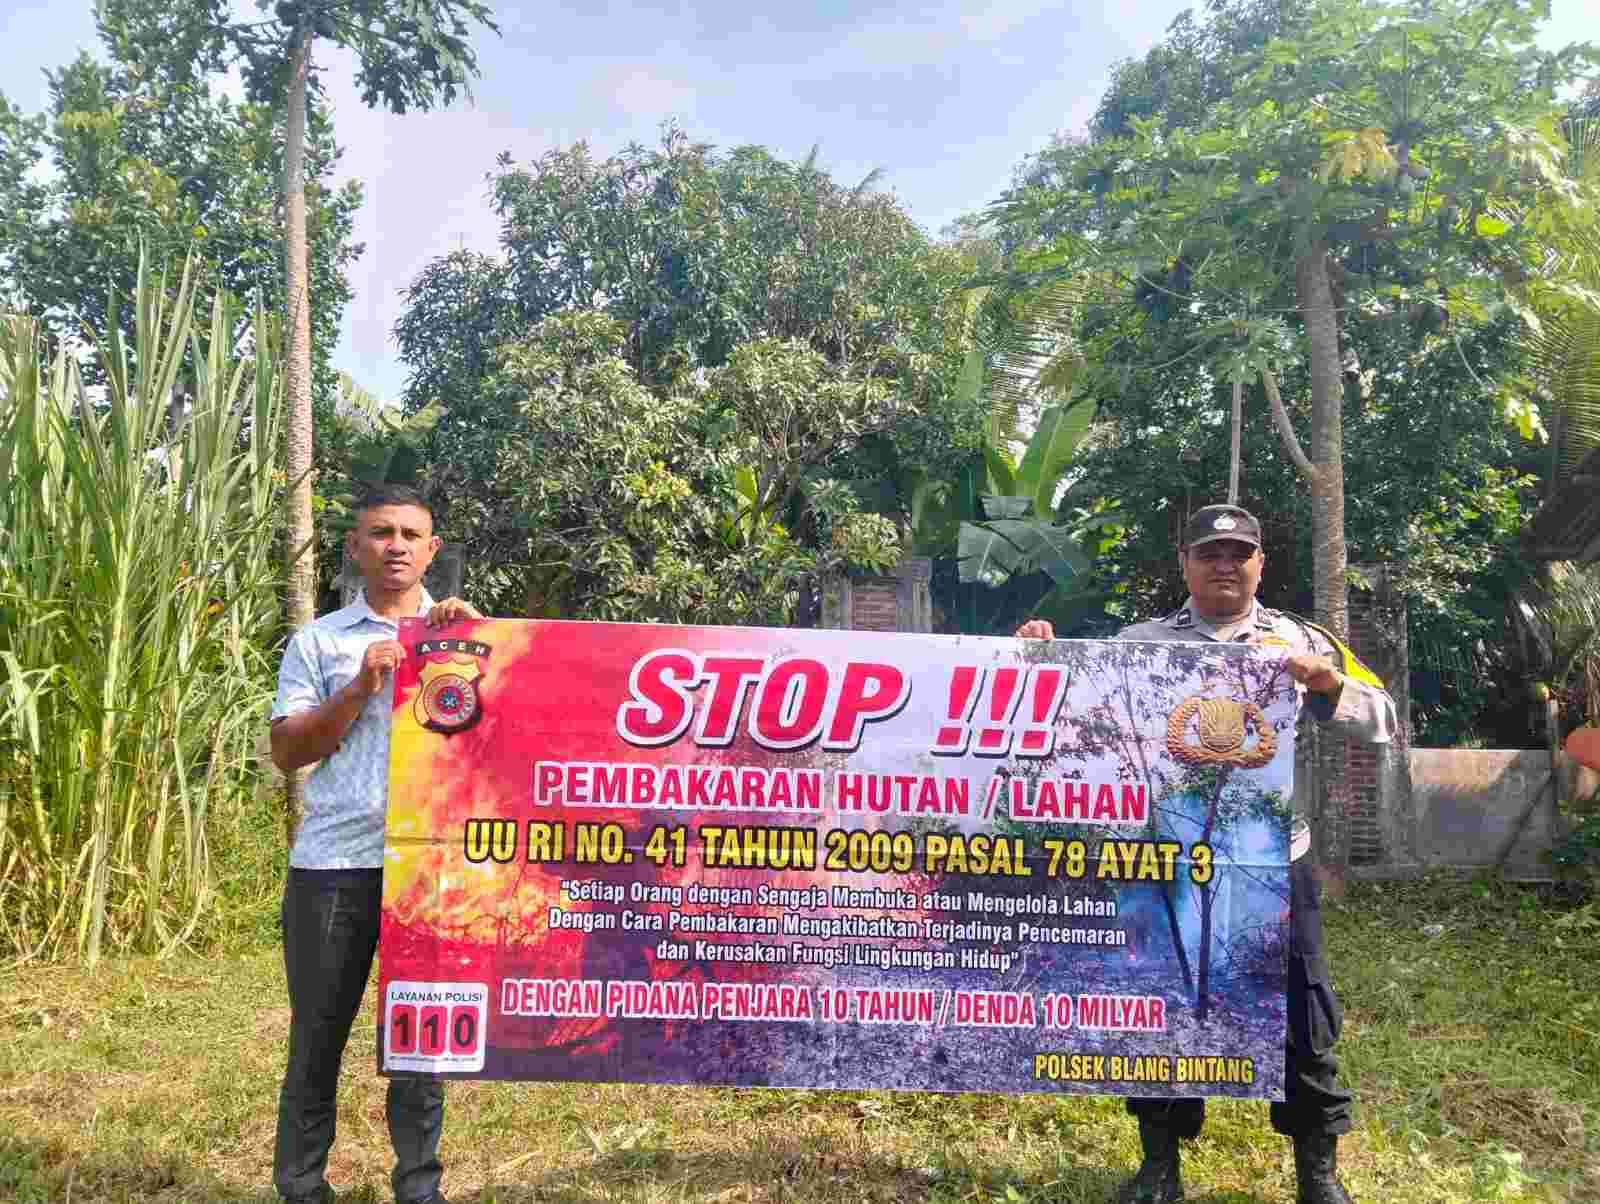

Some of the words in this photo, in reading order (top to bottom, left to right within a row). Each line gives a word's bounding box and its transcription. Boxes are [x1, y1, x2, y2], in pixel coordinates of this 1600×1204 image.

[421, 640, 486, 654] ACEH
[617, 648, 910, 752] STOP
[931, 663, 1070, 758] !!!
[536, 763, 822, 811] PEMBAKARAN
[837, 773, 971, 816] HUTAN
[1009, 776, 1151, 825] LAHAN
[465, 819, 515, 863] UU
[527, 822, 565, 863] RI
[575, 825, 634, 866] NO.
[645, 826, 687, 866] 41
[700, 828, 817, 870] TAHUN
[825, 830, 914, 873] 2009
[926, 835, 1033, 877] PASAL
[1044, 840, 1087, 878] 78
[1097, 842, 1182, 882] AYAT
[1191, 845, 1213, 883] 3
[561, 880, 625, 905] "Setiap
[630, 883, 683, 907] Orang
[688, 885, 752, 908] dengan
[757, 885, 826, 910] Sengaja
[833, 887, 917, 909] Membuka
[922, 891, 961, 911] atau
[967, 893, 1059, 915] Mengelola
[1063, 897, 1117, 917] Lahan
[549, 909, 616, 933] Dengan
[621, 912, 664, 932] Cara
[668, 914, 777, 934] Pembakaran
[783, 914, 918, 938] Mengakibatkan
[922, 919, 1012, 943] Terjadinya
[1018, 926, 1127, 946] Pencemaran
[657, 940, 690, 961] dan
[695, 941, 786, 962] Kerusakan
[792, 944, 850, 966] Fungsi
[854, 946, 955, 969] Lingkungan
[391, 991, 441, 1002] LAYANAN
[446, 992, 482, 1002] POLISI
[501, 979, 602, 1016] DENGAN
[607, 981, 697, 1018] PIDANA
[702, 984, 814, 1021] PENJARA
[820, 989, 848, 1020] 10
[856, 991, 935, 1024] TAHUN
[956, 993, 1033, 1026] DENDA
[1042, 995, 1071, 1028] 10
[1078, 997, 1165, 1031] MILYAR
[1035, 1056, 1105, 1080] POLSEK
[1110, 1057, 1170, 1081] BLANG
[1177, 1058, 1254, 1084] BINTANG
